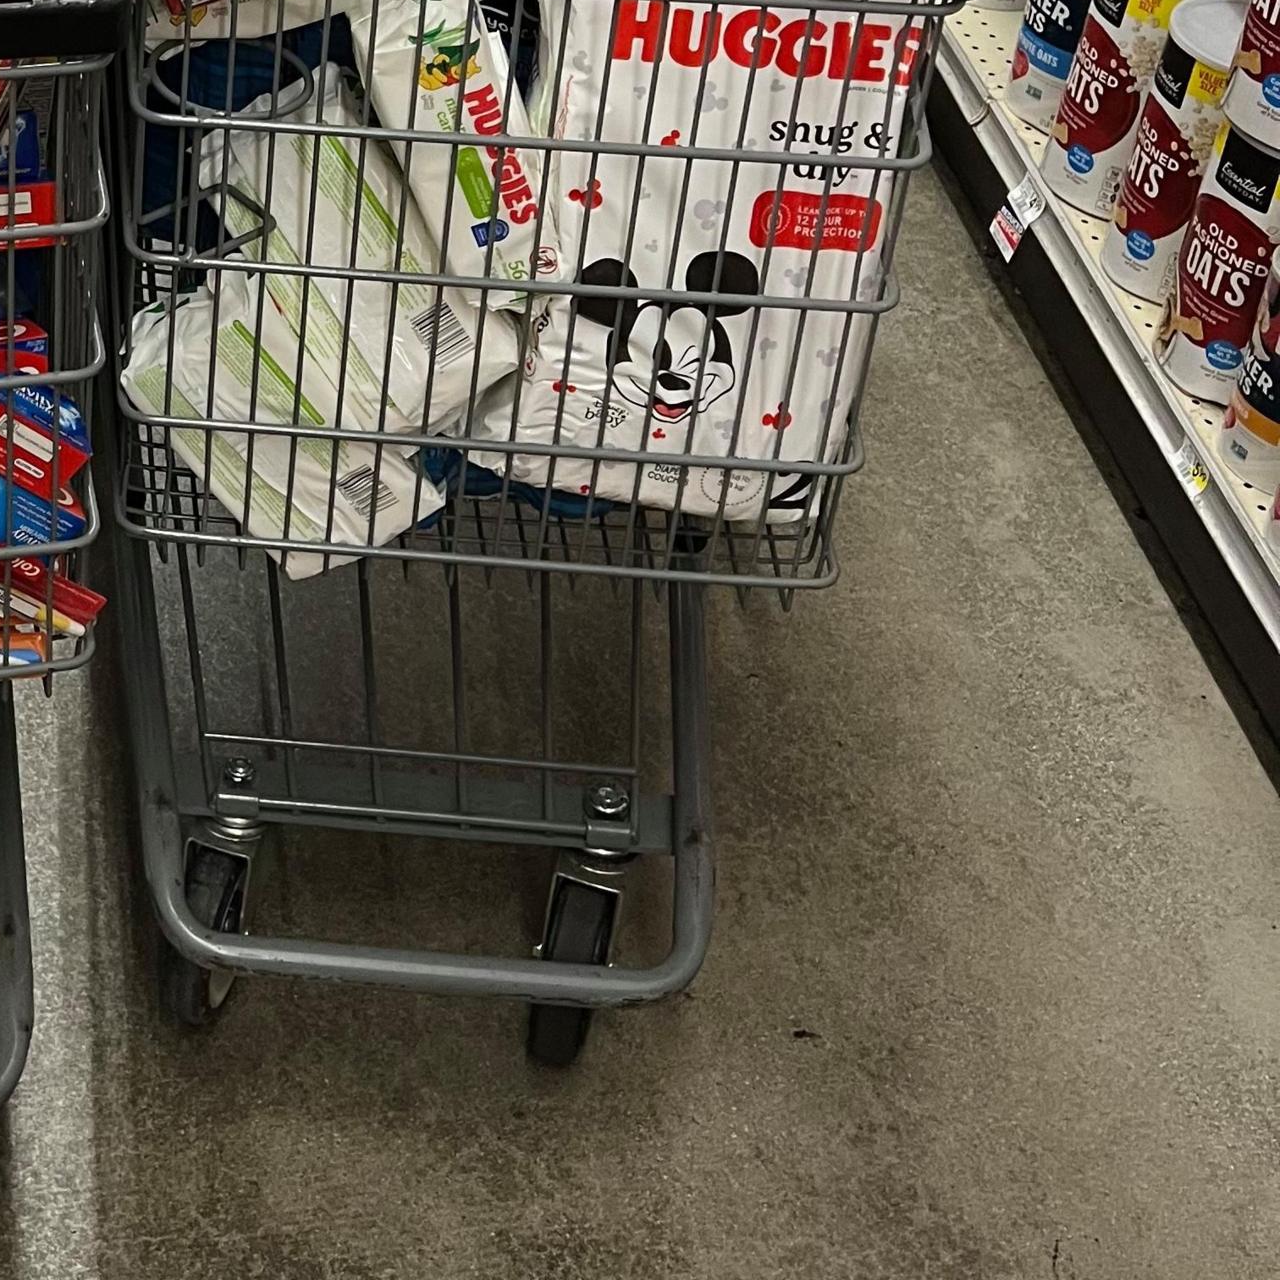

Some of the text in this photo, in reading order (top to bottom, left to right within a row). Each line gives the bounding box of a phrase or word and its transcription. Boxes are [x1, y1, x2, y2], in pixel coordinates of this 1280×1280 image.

[1036, 48, 1058, 68] OATS
[1080, 35, 1099, 61] OLD
[1198, 69, 1226, 89] VALUE
[1199, 79, 1218, 96] SIZE
[769, 120, 894, 152] snug &
[1141, 116, 1159, 143] OLD
[1221, 161, 1267, 197] Essential
[796, 215, 810, 227] 12
[1191, 217, 1269, 277] FASHIONED
[1209, 222, 1239, 250] OLD
[506, 258, 525, 282] 56
[1186, 237, 1251, 308] OATS
